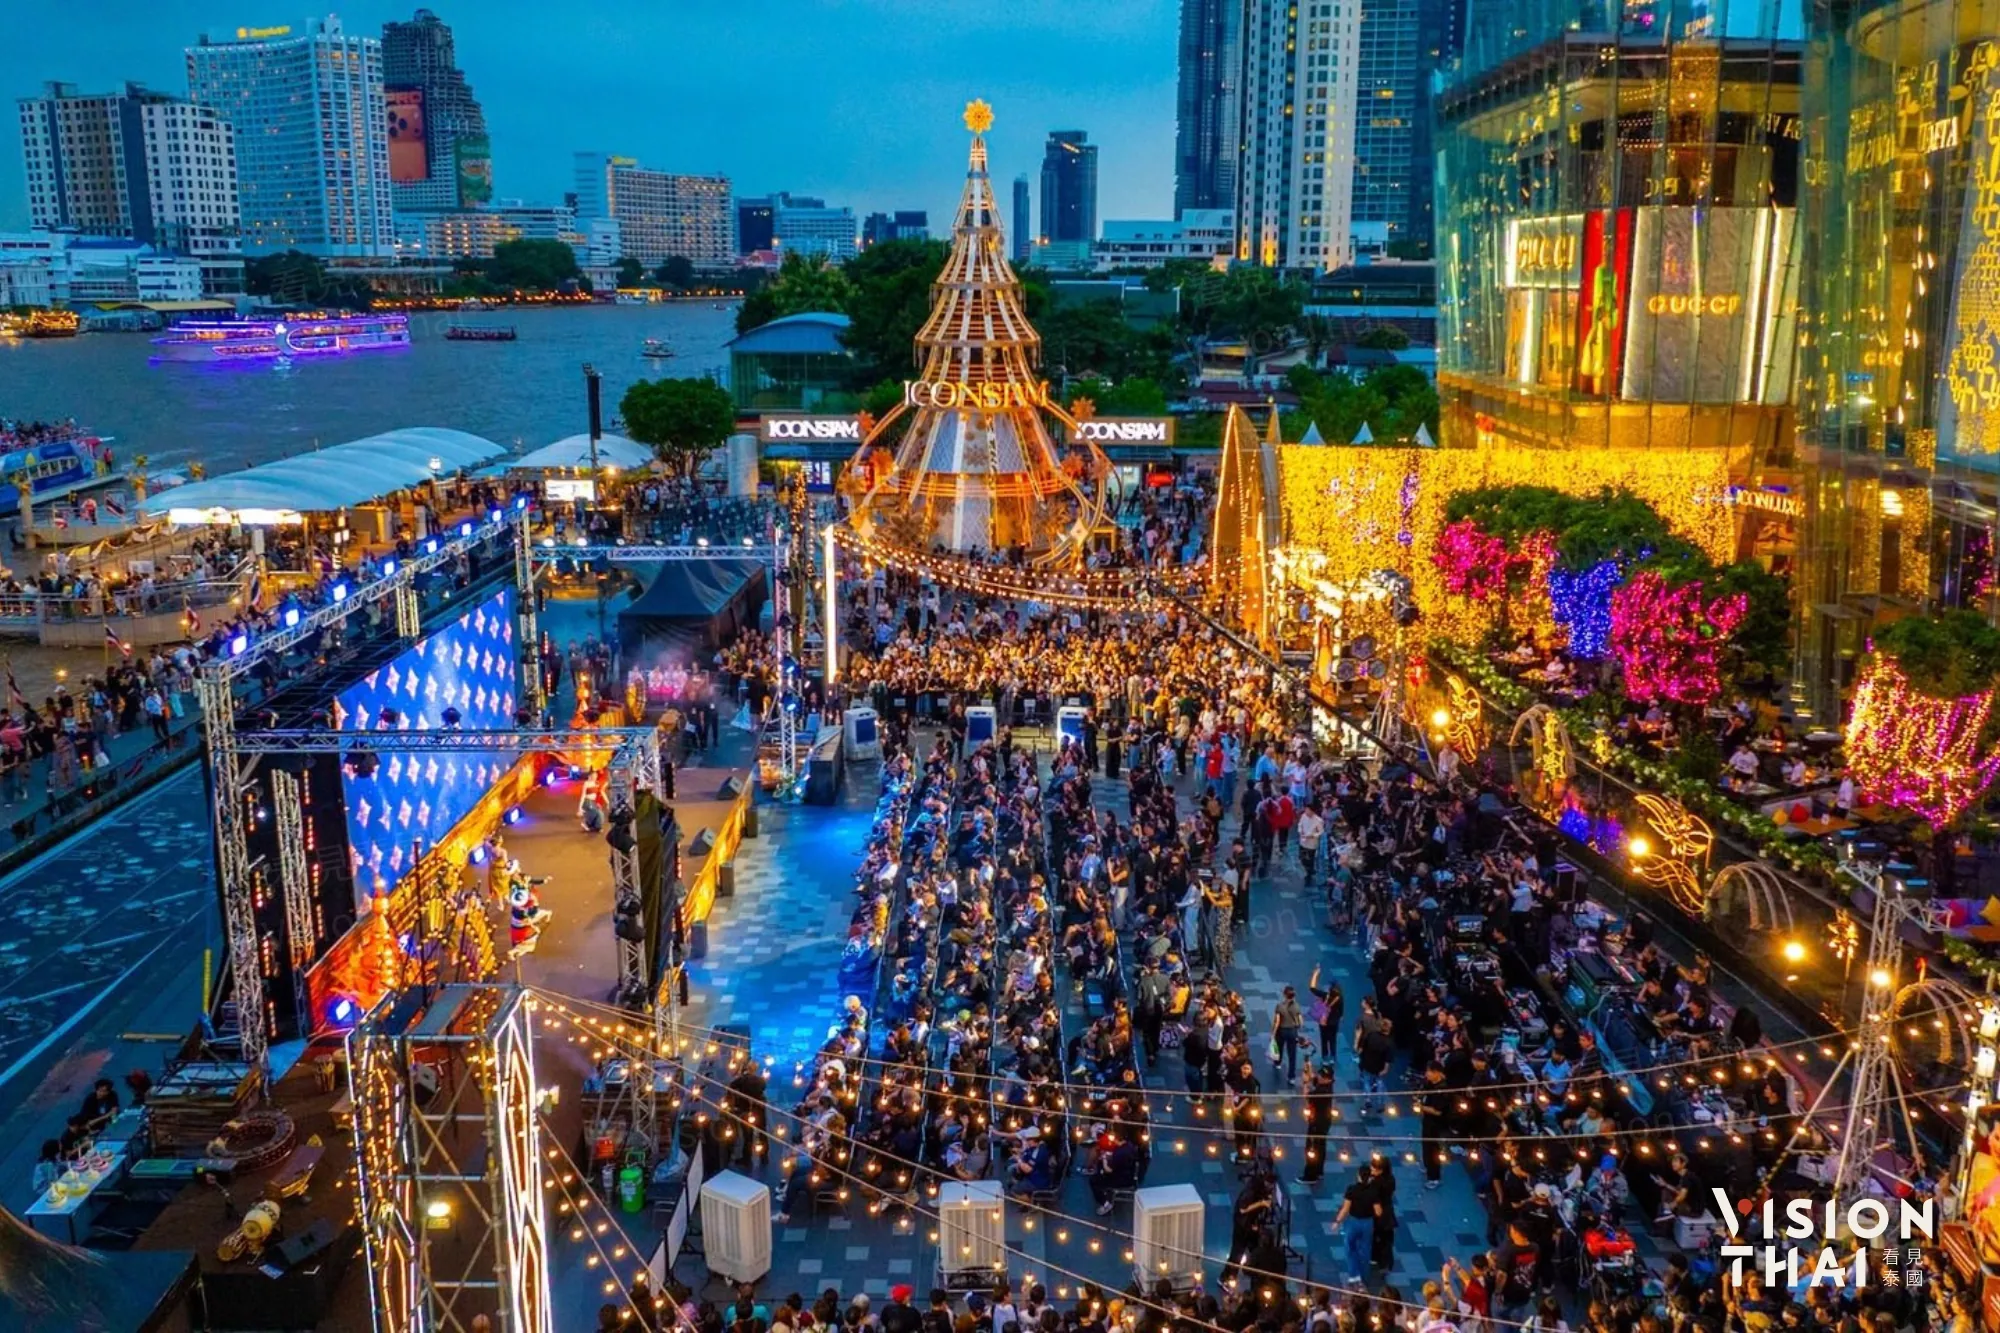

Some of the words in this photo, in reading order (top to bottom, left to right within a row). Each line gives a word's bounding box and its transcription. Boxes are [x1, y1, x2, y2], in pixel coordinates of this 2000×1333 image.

[1648, 295, 1741, 315] GUCCI
[904, 380, 1049, 408] ICONSIAM
[768, 420, 860, 439] ICONSIAM
[1075, 420, 1166, 440] ICONSIAM
